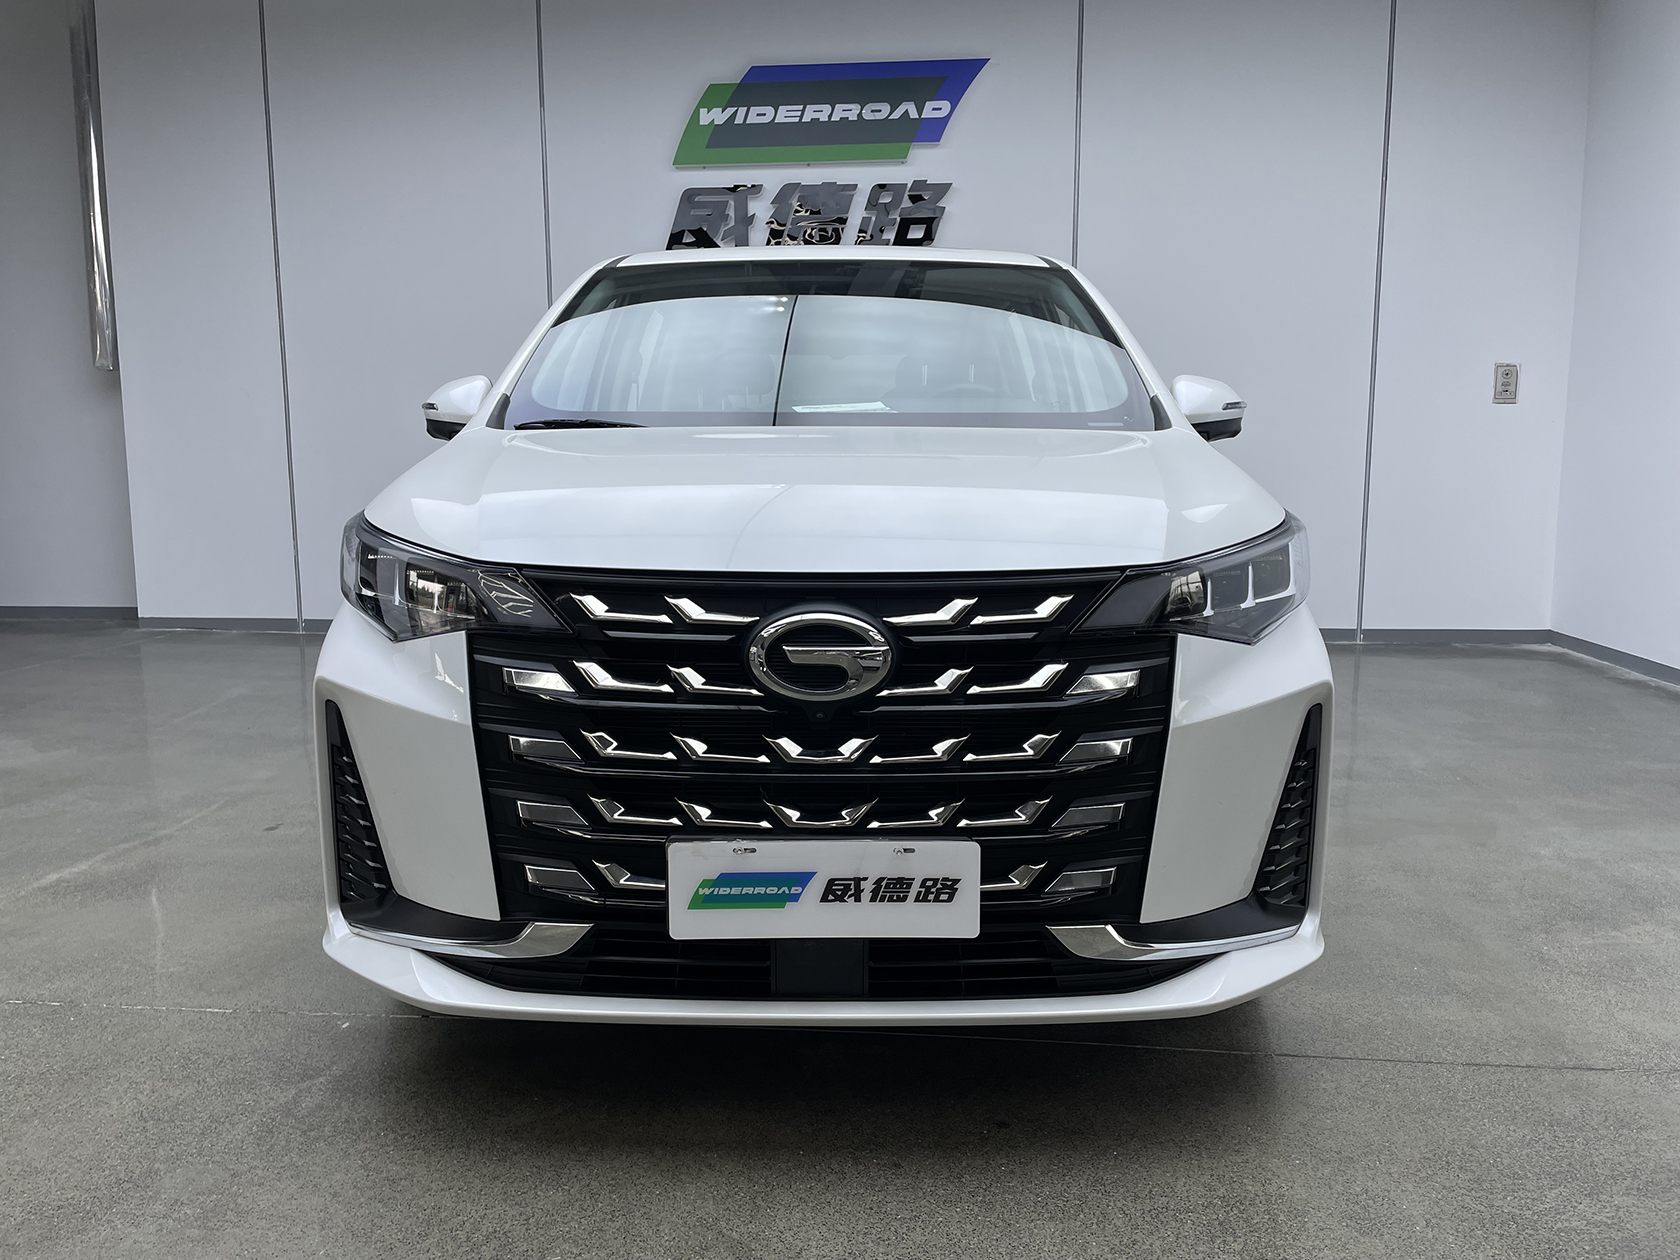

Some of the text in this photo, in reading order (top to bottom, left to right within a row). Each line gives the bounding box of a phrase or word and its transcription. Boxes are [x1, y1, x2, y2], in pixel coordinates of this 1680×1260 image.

[699, 100, 951, 125] WIDERROAD
[665, 180, 953, 250] 威德路
[698, 886, 803, 895] WIDERROAD
[819, 876, 962, 904] 威德路
